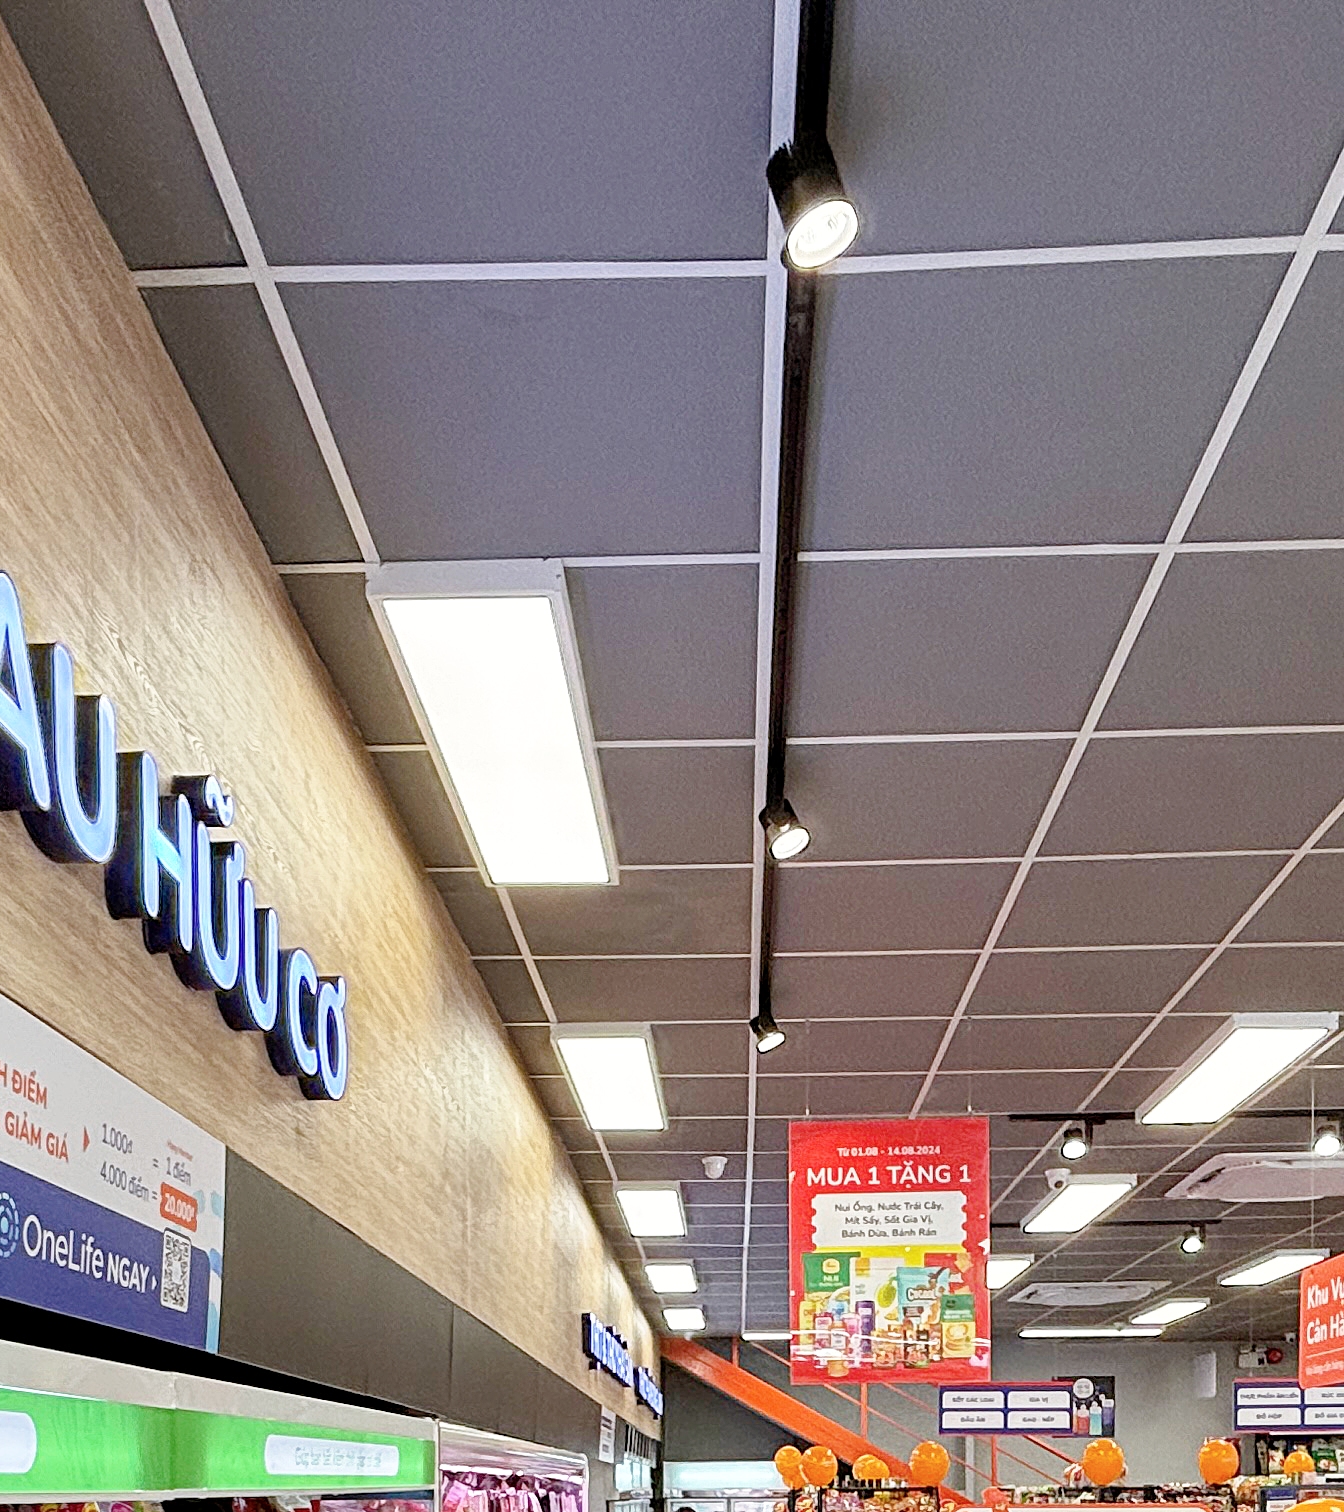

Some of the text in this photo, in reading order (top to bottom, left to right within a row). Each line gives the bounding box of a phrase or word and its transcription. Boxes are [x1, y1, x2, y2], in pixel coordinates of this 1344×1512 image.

[286, 946, 348, 1101] CƠ
[12, 1069, 48, 1110] ĐIỂM
[4, 1111, 42, 1150] GIẢM
[45, 1132, 69, 1163] GIÁ
[807, 1160, 972, 1189] MUA 1 TẶNG 1
[22, 1215, 106, 1280] OneLife
[106, 1252, 151, 1294] NGAY
[1306, 1283, 1329, 1311] Khu
[1306, 1316, 1328, 1345] Cân
